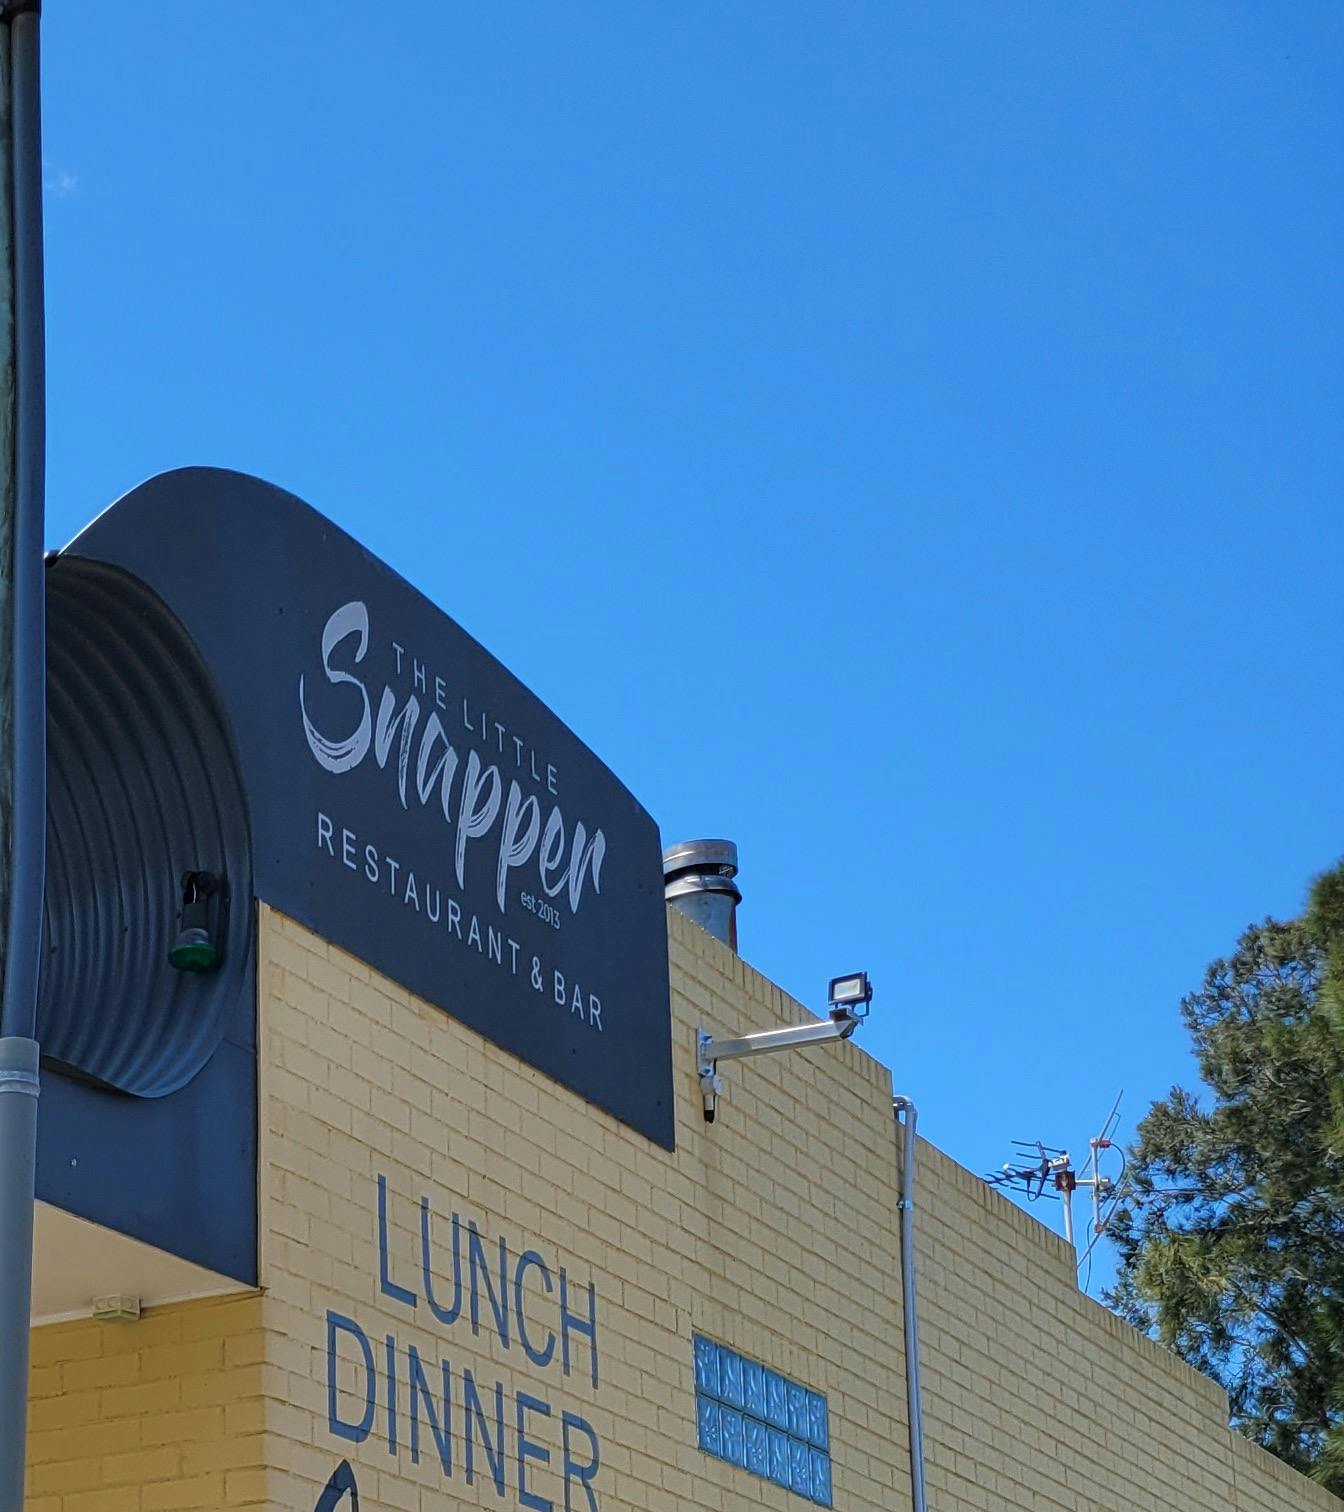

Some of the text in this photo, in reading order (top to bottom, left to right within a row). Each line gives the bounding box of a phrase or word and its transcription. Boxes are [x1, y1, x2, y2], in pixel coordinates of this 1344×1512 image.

[299, 600, 607, 914] Snapper
[391, 641, 559, 796] THE LITTLE
[317, 811, 603, 1032] RESTAURANT & BAR
[520, 891, 561, 930] est 2013
[377, 1172, 599, 1389] LUNCH
